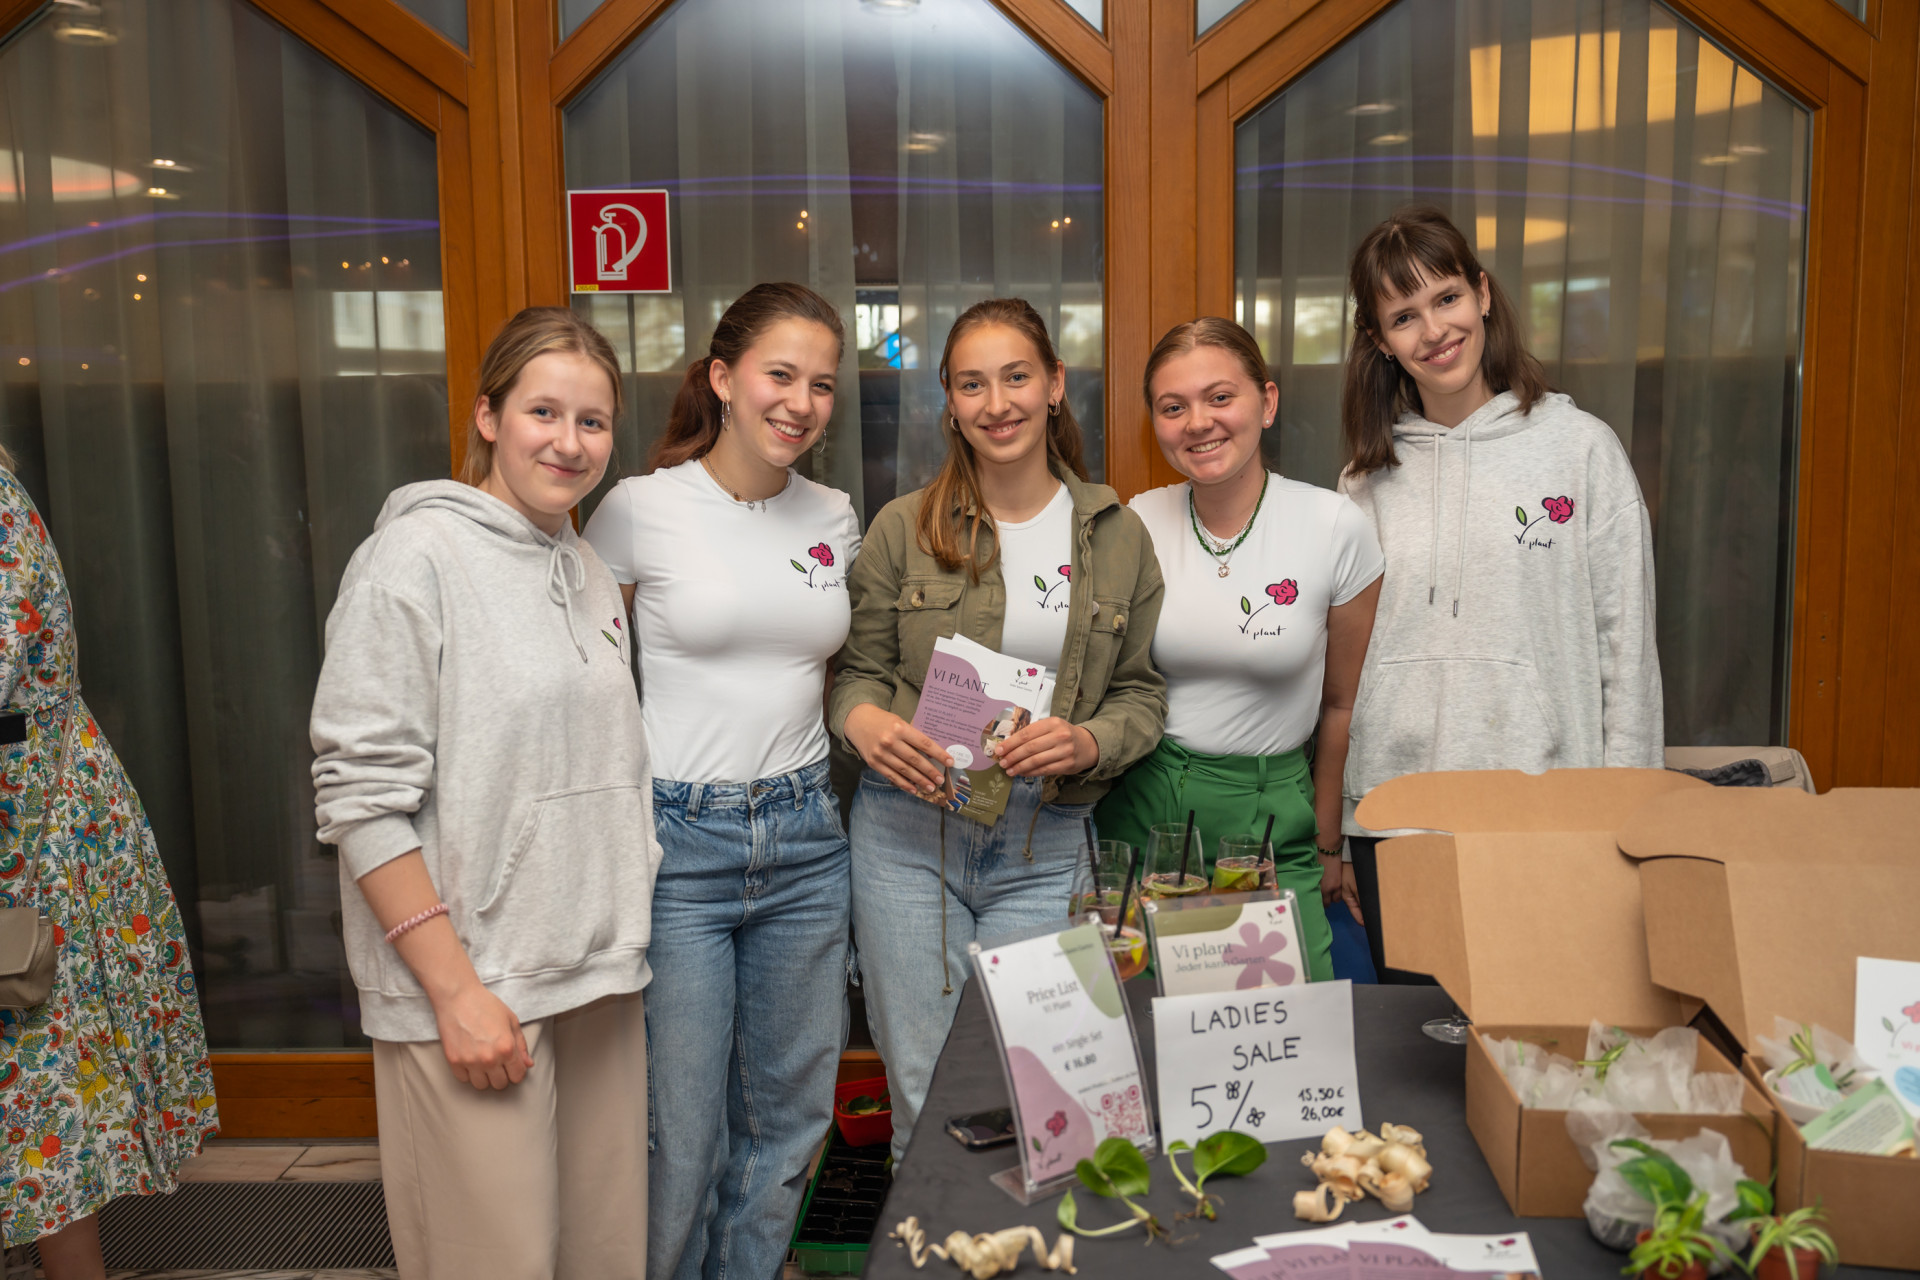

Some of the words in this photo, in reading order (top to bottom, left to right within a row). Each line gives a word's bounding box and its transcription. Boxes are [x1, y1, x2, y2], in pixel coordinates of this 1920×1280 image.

[934, 668, 946, 682] VI
[948, 672, 989, 694] PLANT
[1172, 944, 1189, 959] Vi
[1193, 942, 1233, 960] plant
[1026, 987, 1056, 1005] Price
[1056, 980, 1079, 996] List
[1191, 1000, 1288, 1034] LADIES
[1232, 1036, 1301, 1071] SALE
